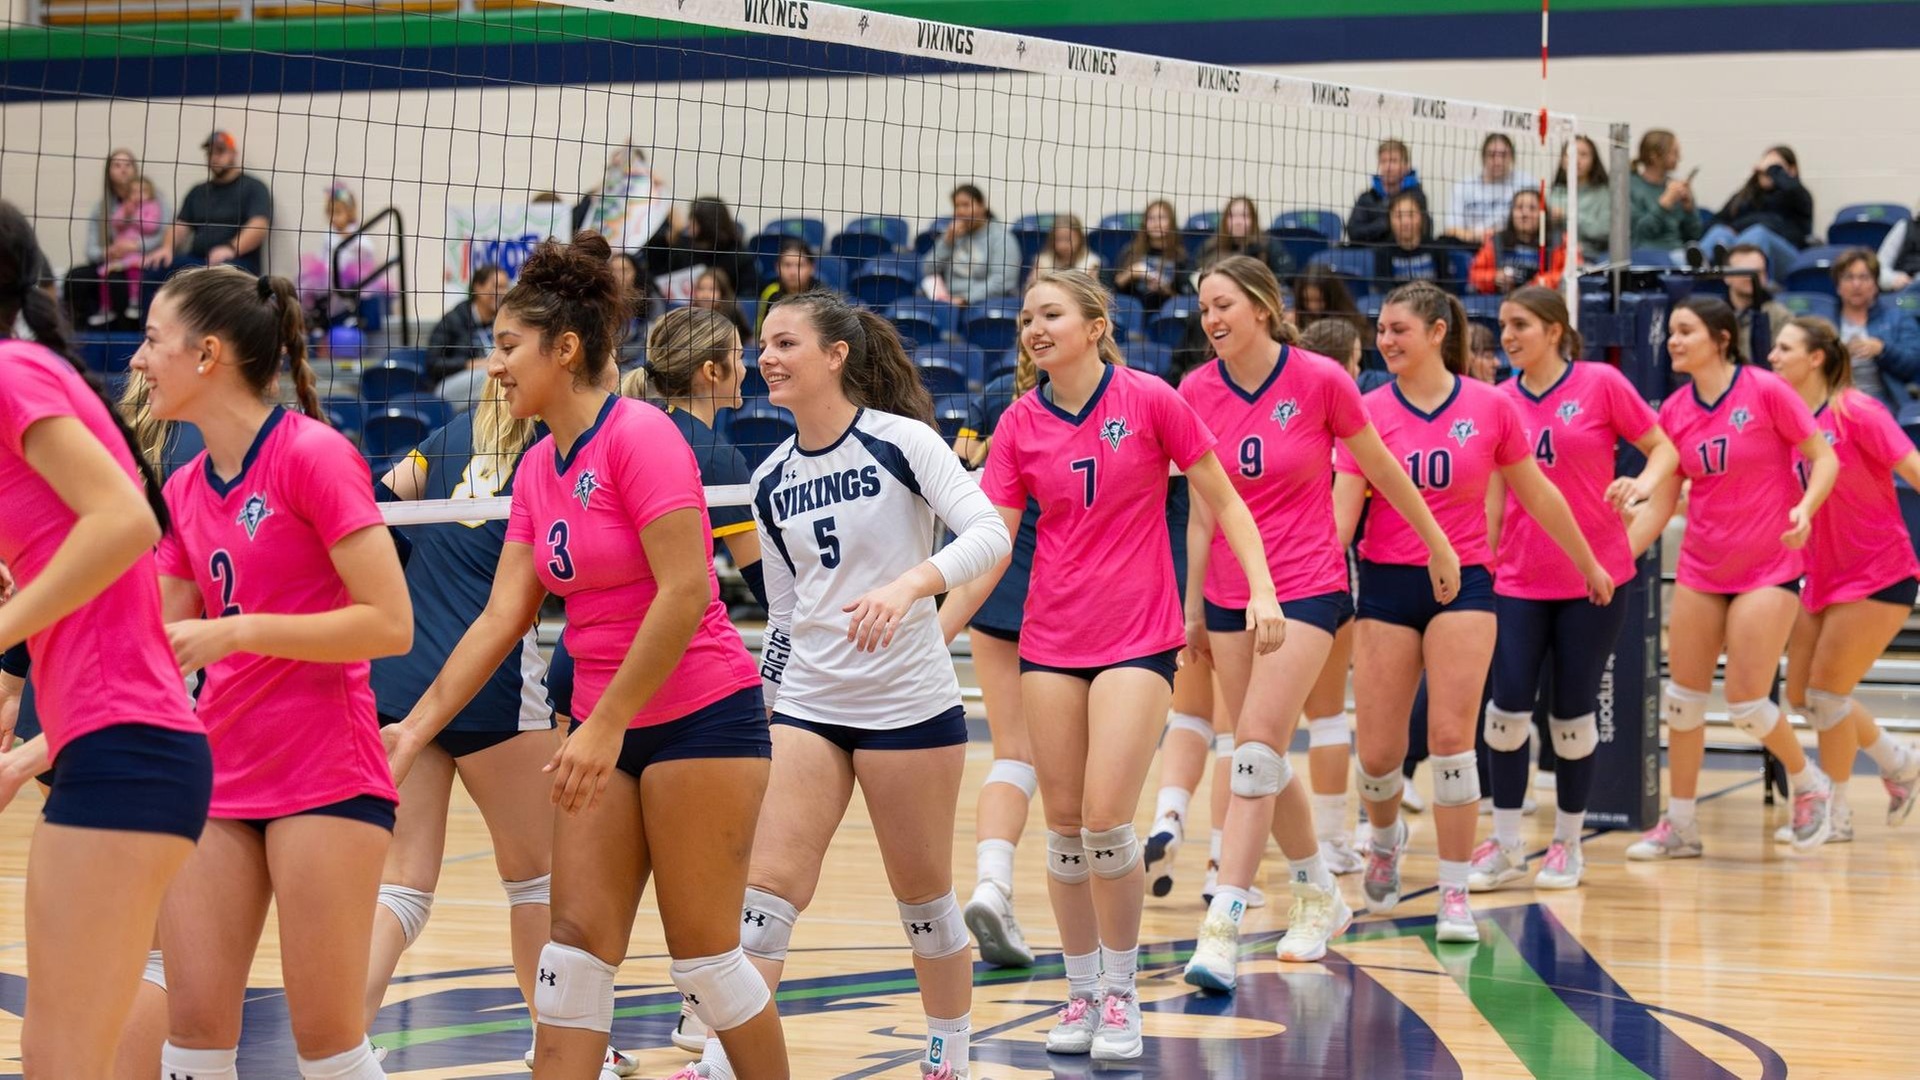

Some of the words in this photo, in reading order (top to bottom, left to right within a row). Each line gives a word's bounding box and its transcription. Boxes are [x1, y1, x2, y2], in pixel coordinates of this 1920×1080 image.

[744, 0, 809, 29] VIKINGS
[917, 22, 974, 55] VIKINGS
[1068, 45, 1117, 75] VIKINGS
[1198, 66, 1241, 93] VIKINGS
[1312, 82, 1350, 108] VIKINGS
[1239, 434, 1264, 479] 9
[1407, 448, 1452, 490] 10
[1697, 434, 1730, 475] 17
[772, 465, 882, 522] VIKINGS
[1070, 457, 1097, 510] 7
[547, 518, 576, 582] 3
[813, 516, 841, 570] 5
[209, 548, 242, 618] 2
